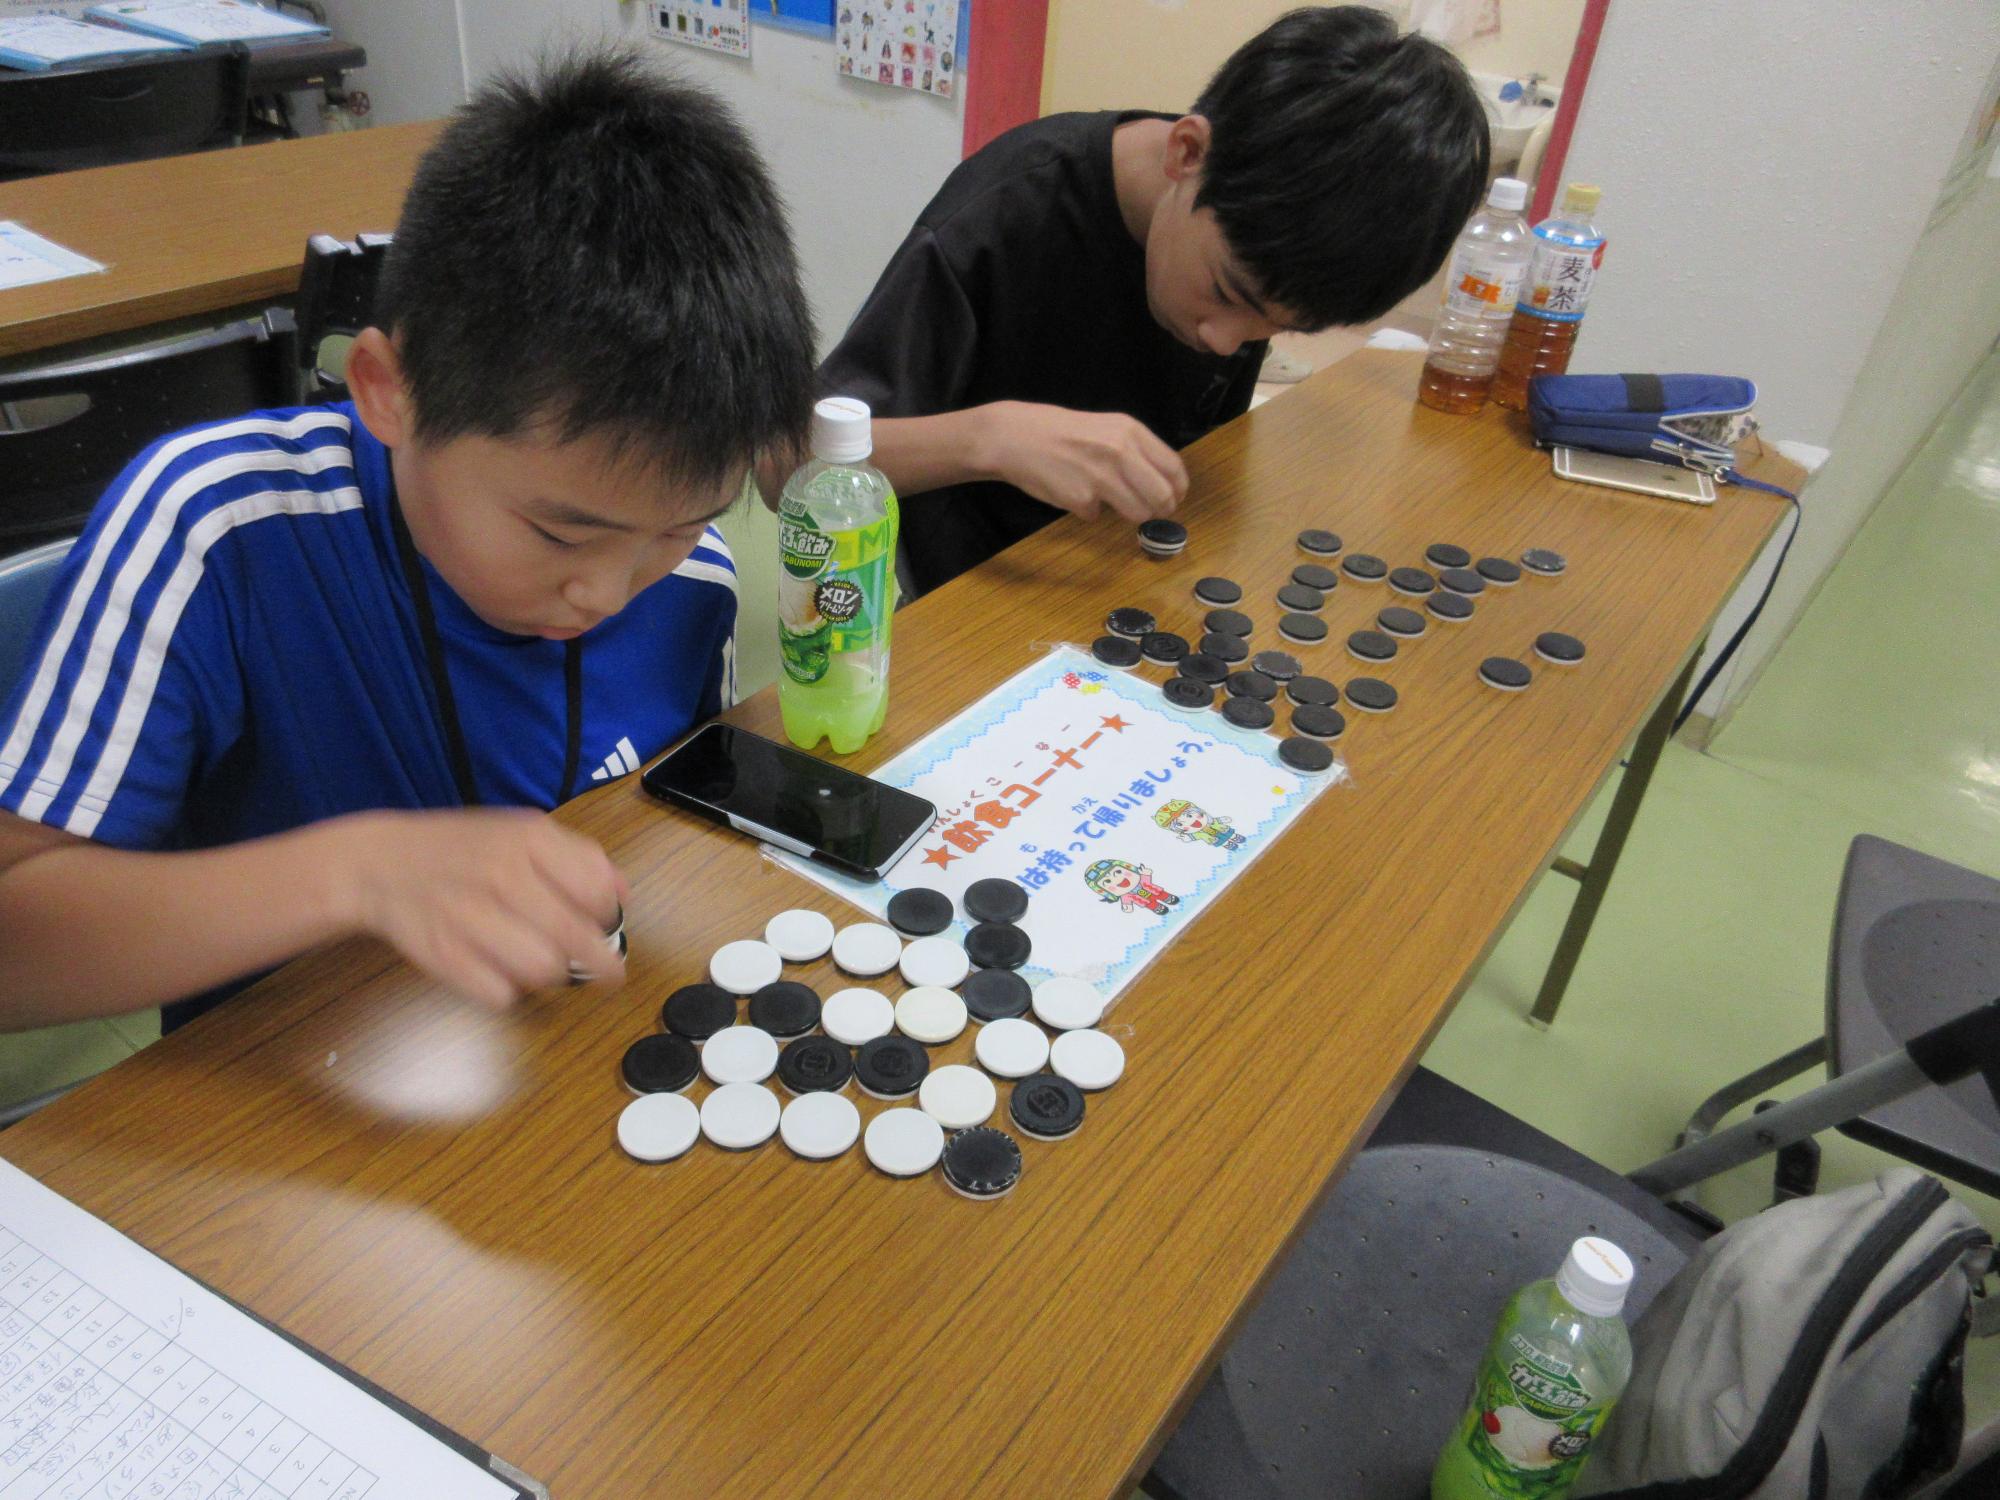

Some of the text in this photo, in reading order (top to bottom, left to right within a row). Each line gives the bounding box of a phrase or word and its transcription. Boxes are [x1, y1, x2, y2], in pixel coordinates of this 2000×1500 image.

[1549, 256, 1585, 310] 麦茶
[819, 586, 860, 605] メロン
[942, 730, 1104, 854] 飲食コーナー
[1015, 740, 1214, 897] は持って帰りましょう。
[1, 1260, 17, 1274] 15
[21, 1275, 39, 1289] 14
[42, 1290, 60, 1304] 13
[62, 1304, 81, 1320] 12
[85, 1320, 103, 1334] 11
[106, 1334, 124, 1349] 10
[131, 1351, 143, 1360] 9
[153, 1365, 165, 1376] 8
[177, 1381, 188, 1391] 7
[198, 1396, 210, 1406] 6
[222, 1411, 234, 1422] 5
[245, 1427, 256, 1438] 4
[268, 1443, 281, 1454] 3
[292, 1459, 305, 1471] 2
[318, 1477, 331, 1487] 1
